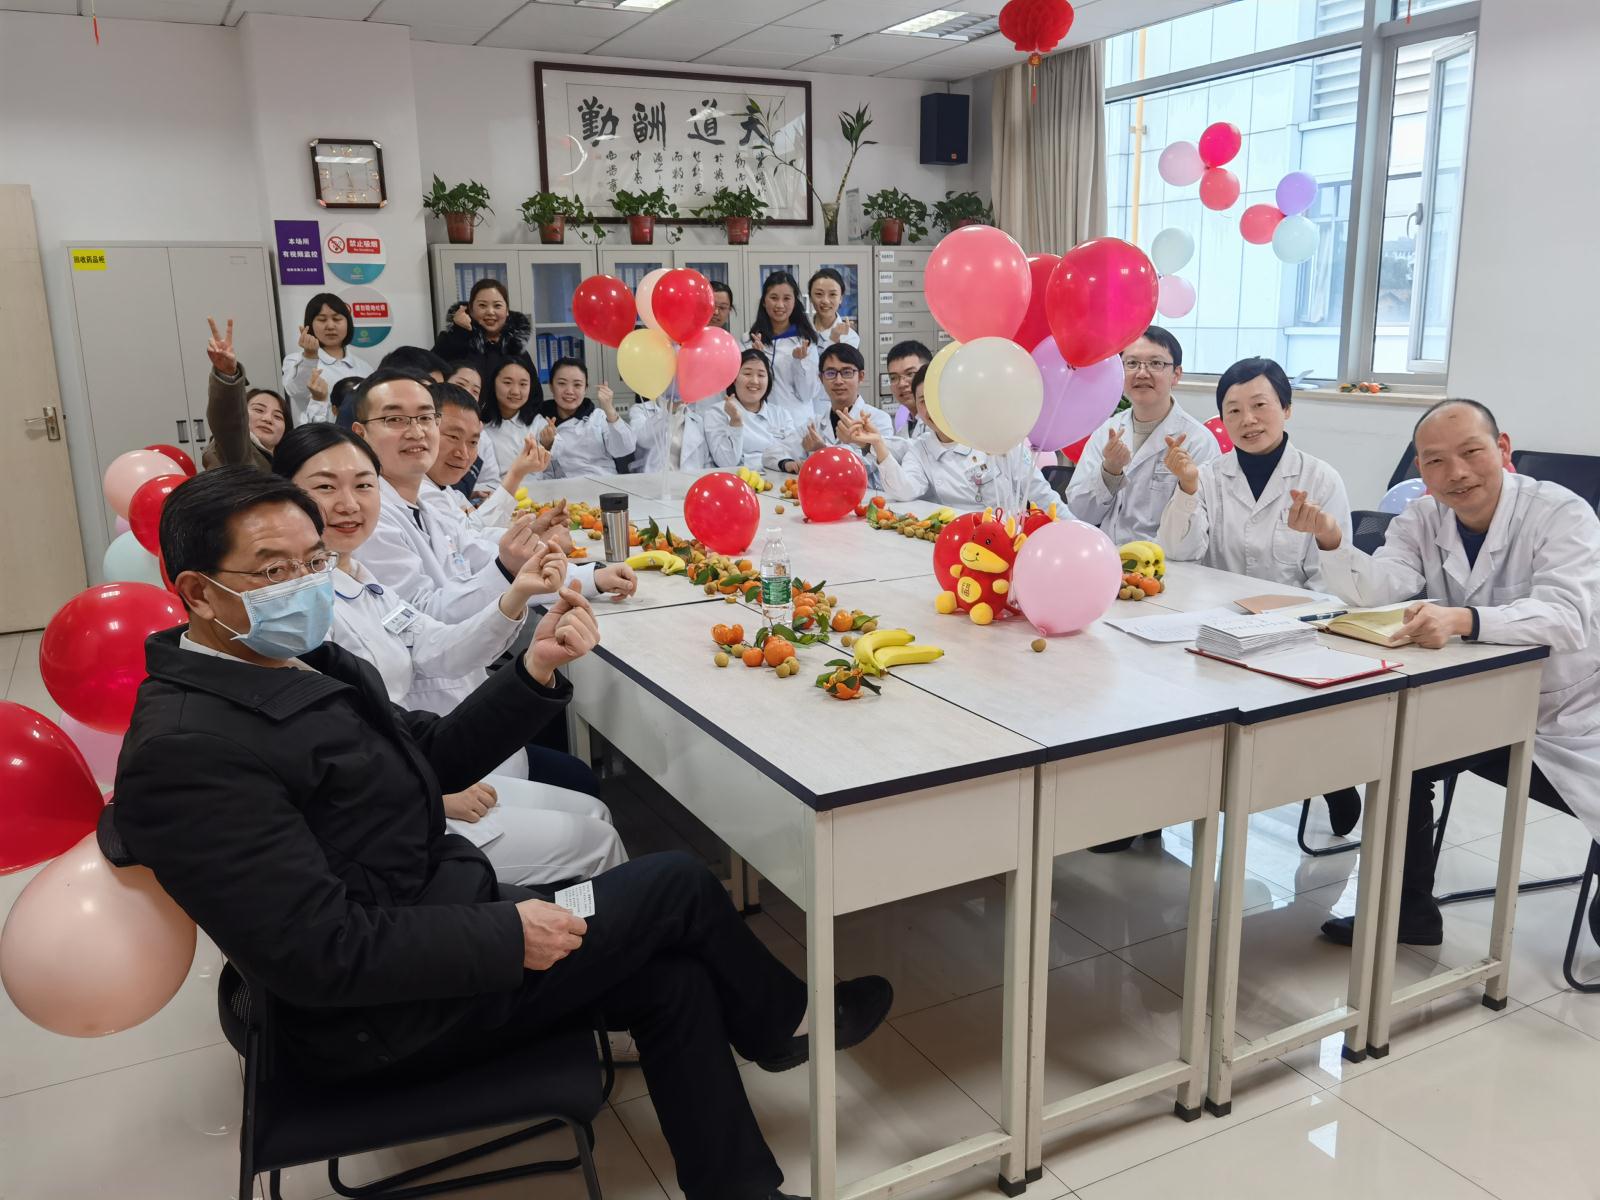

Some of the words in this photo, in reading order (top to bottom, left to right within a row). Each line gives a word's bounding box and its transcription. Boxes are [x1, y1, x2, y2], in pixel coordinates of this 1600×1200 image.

[577, 96, 775, 151] 天道酬勤
[349, 240, 378, 248] 禁止吸烟
